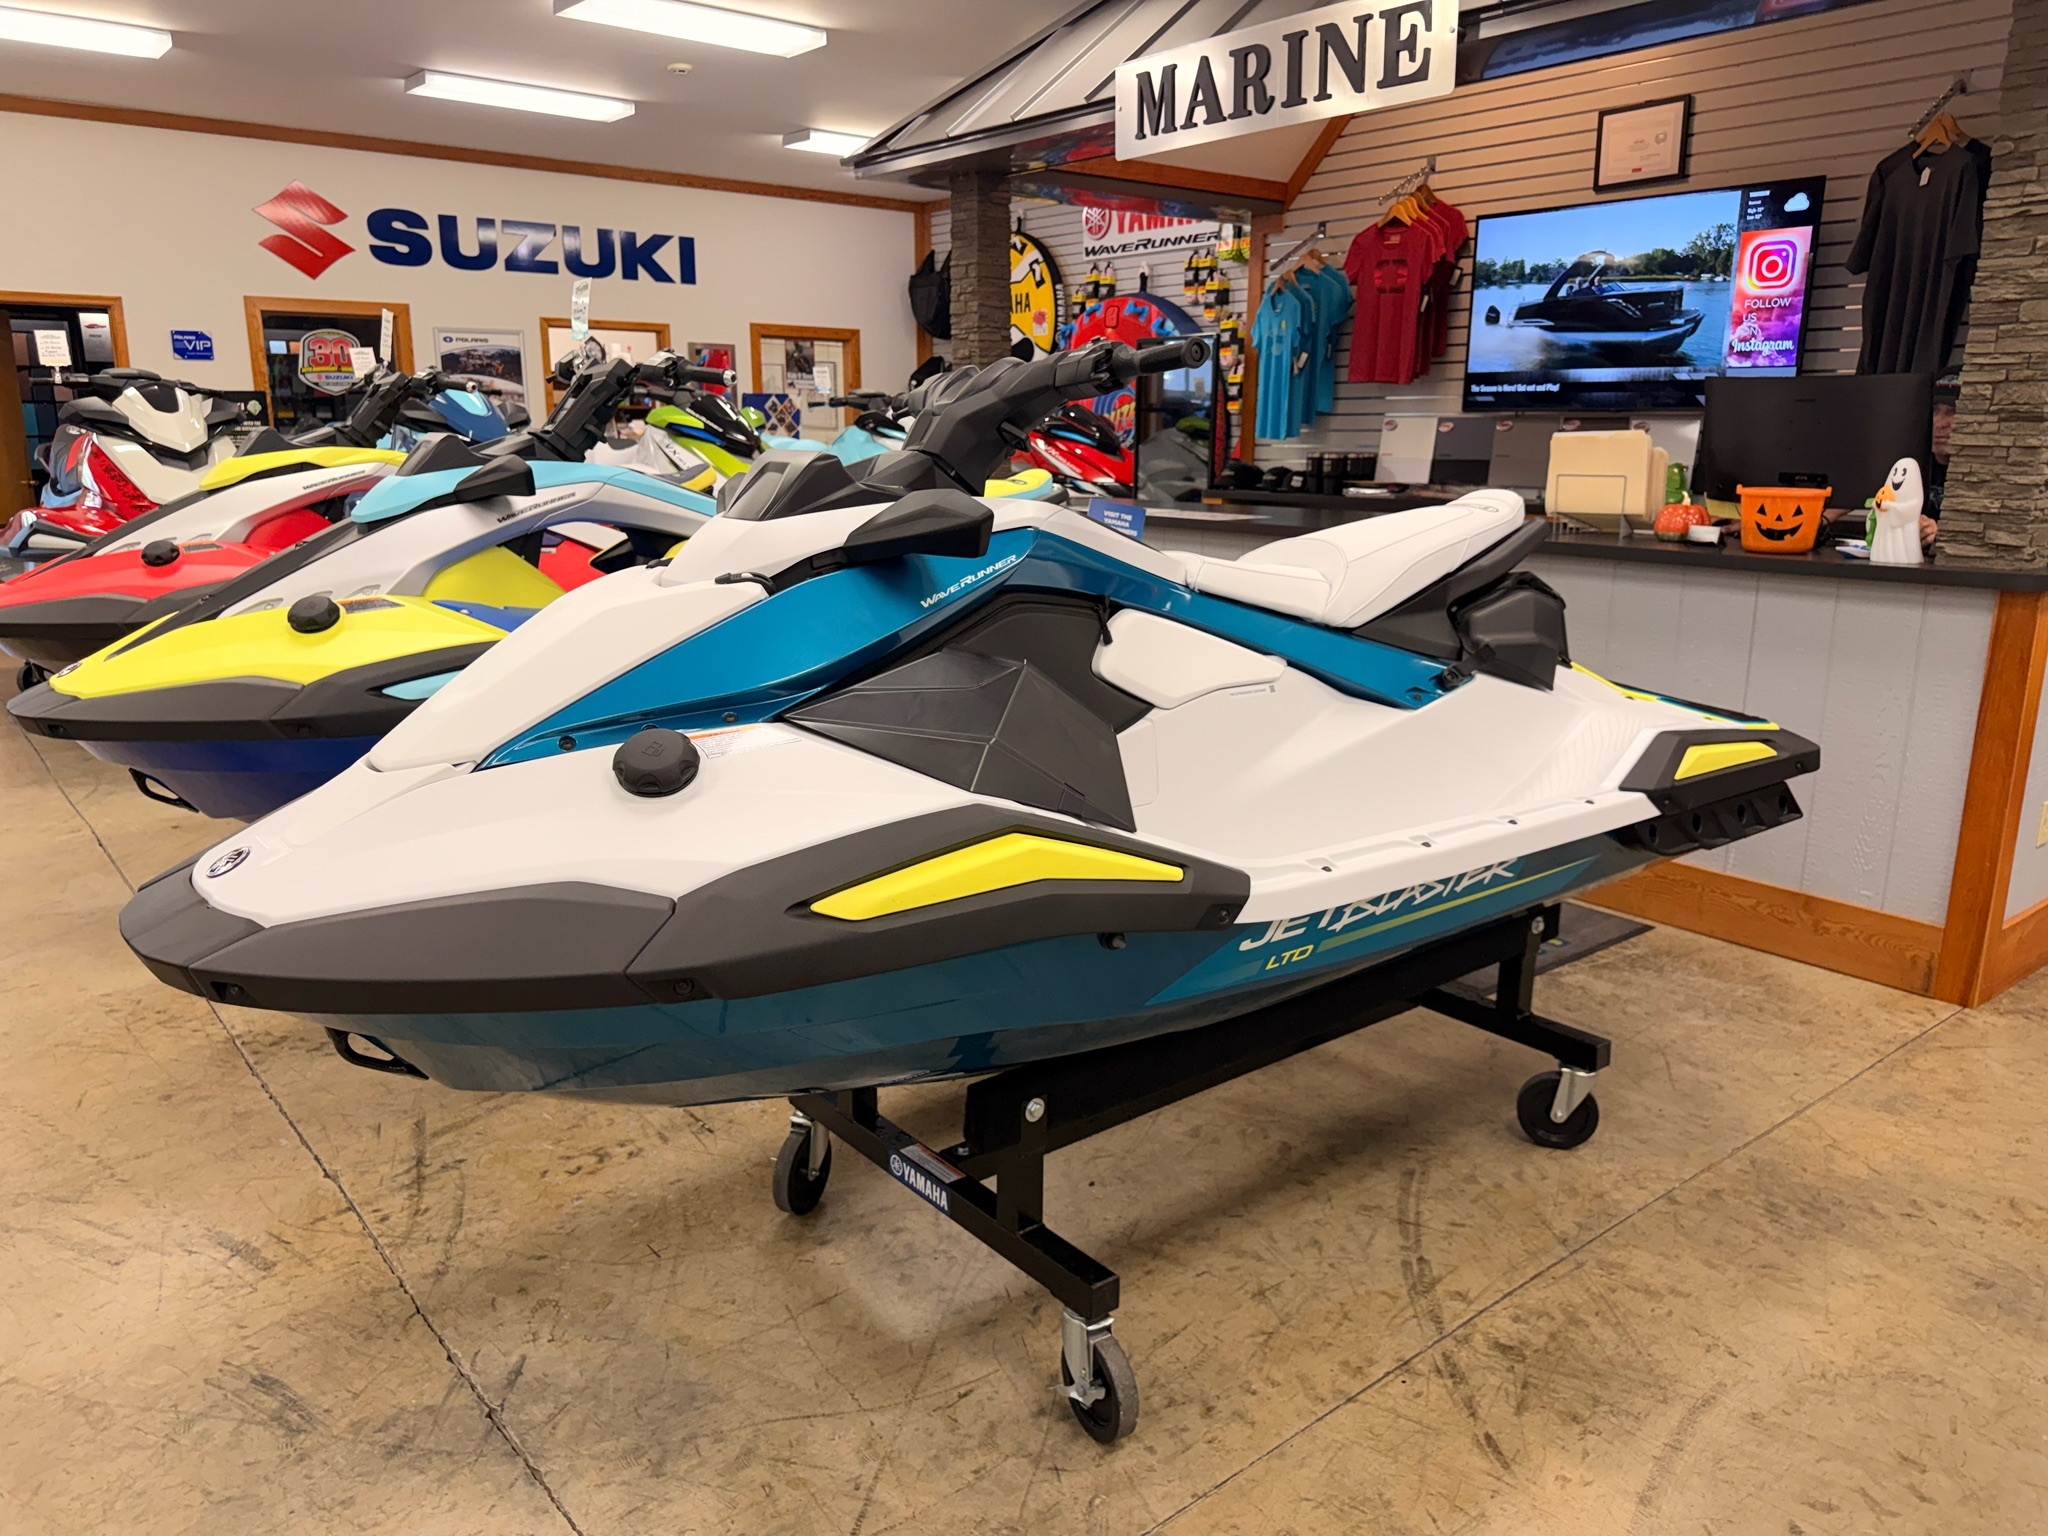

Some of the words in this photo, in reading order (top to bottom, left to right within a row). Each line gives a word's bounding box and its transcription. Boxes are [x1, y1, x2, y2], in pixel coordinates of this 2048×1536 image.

[1135, 0, 1433, 140] MARINE
[1116, 210, 1203, 235] YAM
[366, 208, 697, 285] SUZUKI
[1744, 297, 1792, 309] FOLLOW
[1743, 313, 1758, 322] US
[1741, 327, 1758, 336] ON
[183, 340, 211, 351] VIP
[309, 337, 353, 368] 30
[1731, 338, 1795, 356] Instagram
[1103, 510, 1120, 519] VISIT
[1120, 513, 1133, 521] THE
[1103, 518, 1130, 528] YAMAHA
[920, 554, 1017, 608] WAVERUNNER
[1265, 944, 1315, 970] LTD
[902, 1162, 949, 1211] YAMAHA
